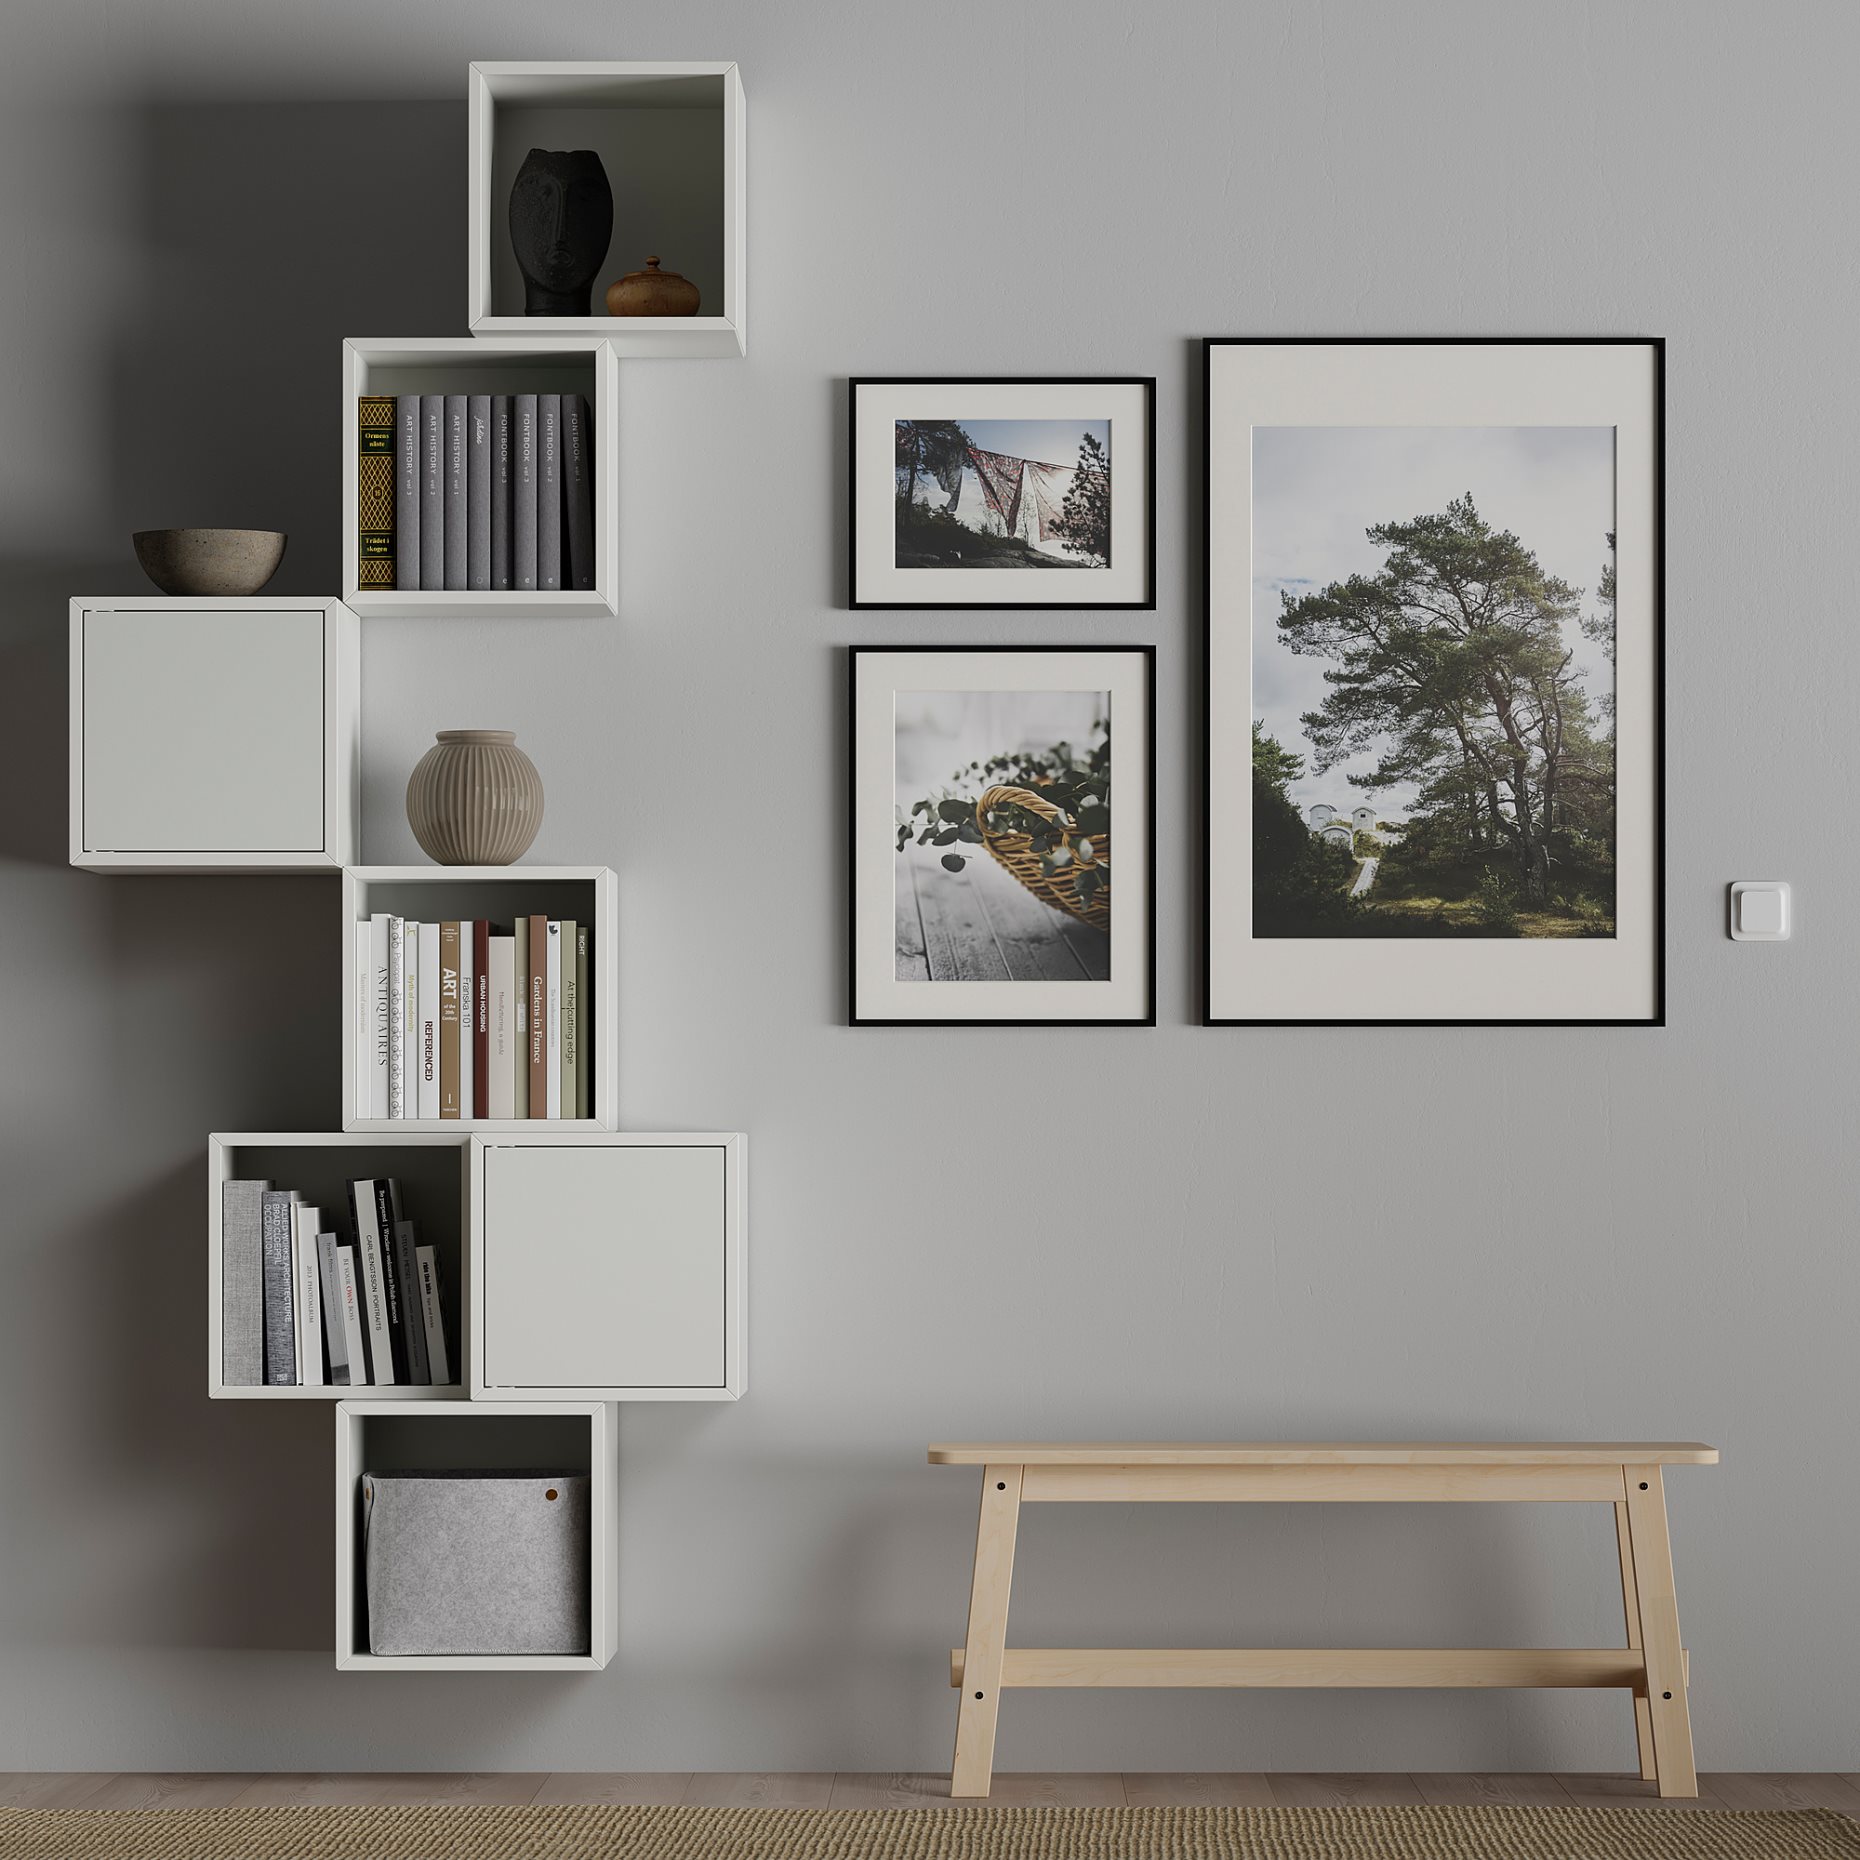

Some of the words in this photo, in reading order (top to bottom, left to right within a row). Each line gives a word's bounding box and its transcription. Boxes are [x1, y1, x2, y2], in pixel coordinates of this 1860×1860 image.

[571, 413, 580, 462] FONTBOOK
[366, 545, 388, 553] skogen
[443, 968, 457, 999] ART
[462, 977, 471, 1011] Franska
[533, 976, 543, 1017] Gardens
[567, 980, 575, 991] At
[567, 993, 575, 1007] the
[376, 965, 388, 1066] ANTIQUAIRES
[462, 1013, 471, 1029] 101
[533, 1018, 543, 1028] in
[565, 1009, 575, 1039] cutting
[425, 1021, 433, 1081] REFERENCED
[533, 1031, 543, 1064] France
[565, 1042, 575, 1065] edge
[379, 1190, 385, 1198] Be
[273, 1203, 281, 1226] BRAD
[281, 1203, 289, 1231] ALLIED
[379, 1197, 388, 1222] prepared
[264, 1204, 273, 1256] OCCUPATION
[366, 1234, 374, 1252] CARL
[282, 1231, 290, 1260] WORKS
[367, 1253, 378, 1293] BENGTSSON
[283, 1262, 292, 1323] ARCHITECTURE
[307, 1280, 315, 1323] PHOTOALBUM
[372, 1294, 382, 1331] PORTRAITS
